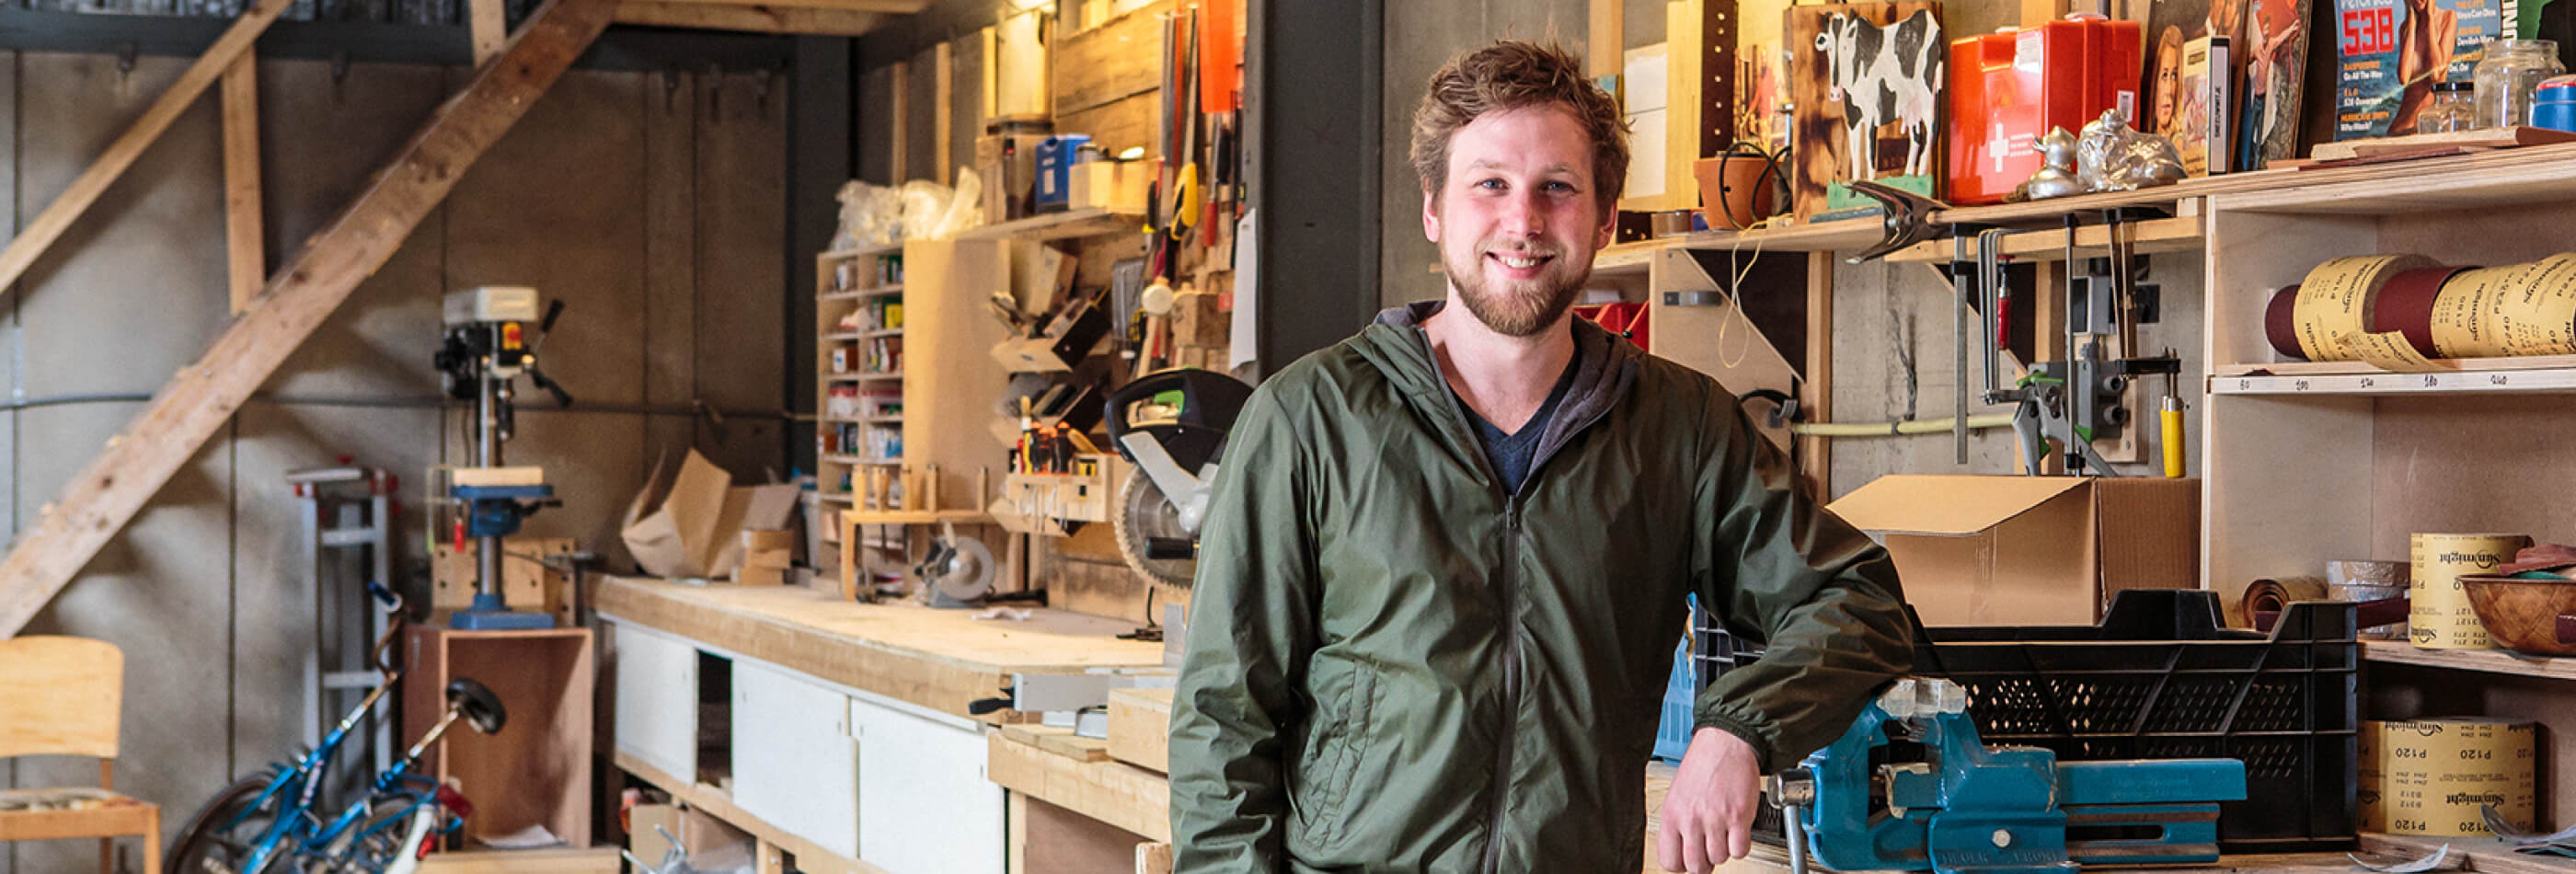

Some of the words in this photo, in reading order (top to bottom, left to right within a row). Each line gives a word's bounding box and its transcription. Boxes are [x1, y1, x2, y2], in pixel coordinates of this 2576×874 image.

[2343, 7, 2394, 56] 538
[2439, 549, 2501, 569] Sunmight
[2395, 748, 2427, 758] P120
[2460, 750, 2491, 759] P120
[2445, 791, 2505, 809] Sunmight
[2395, 820, 2426, 831] P120
